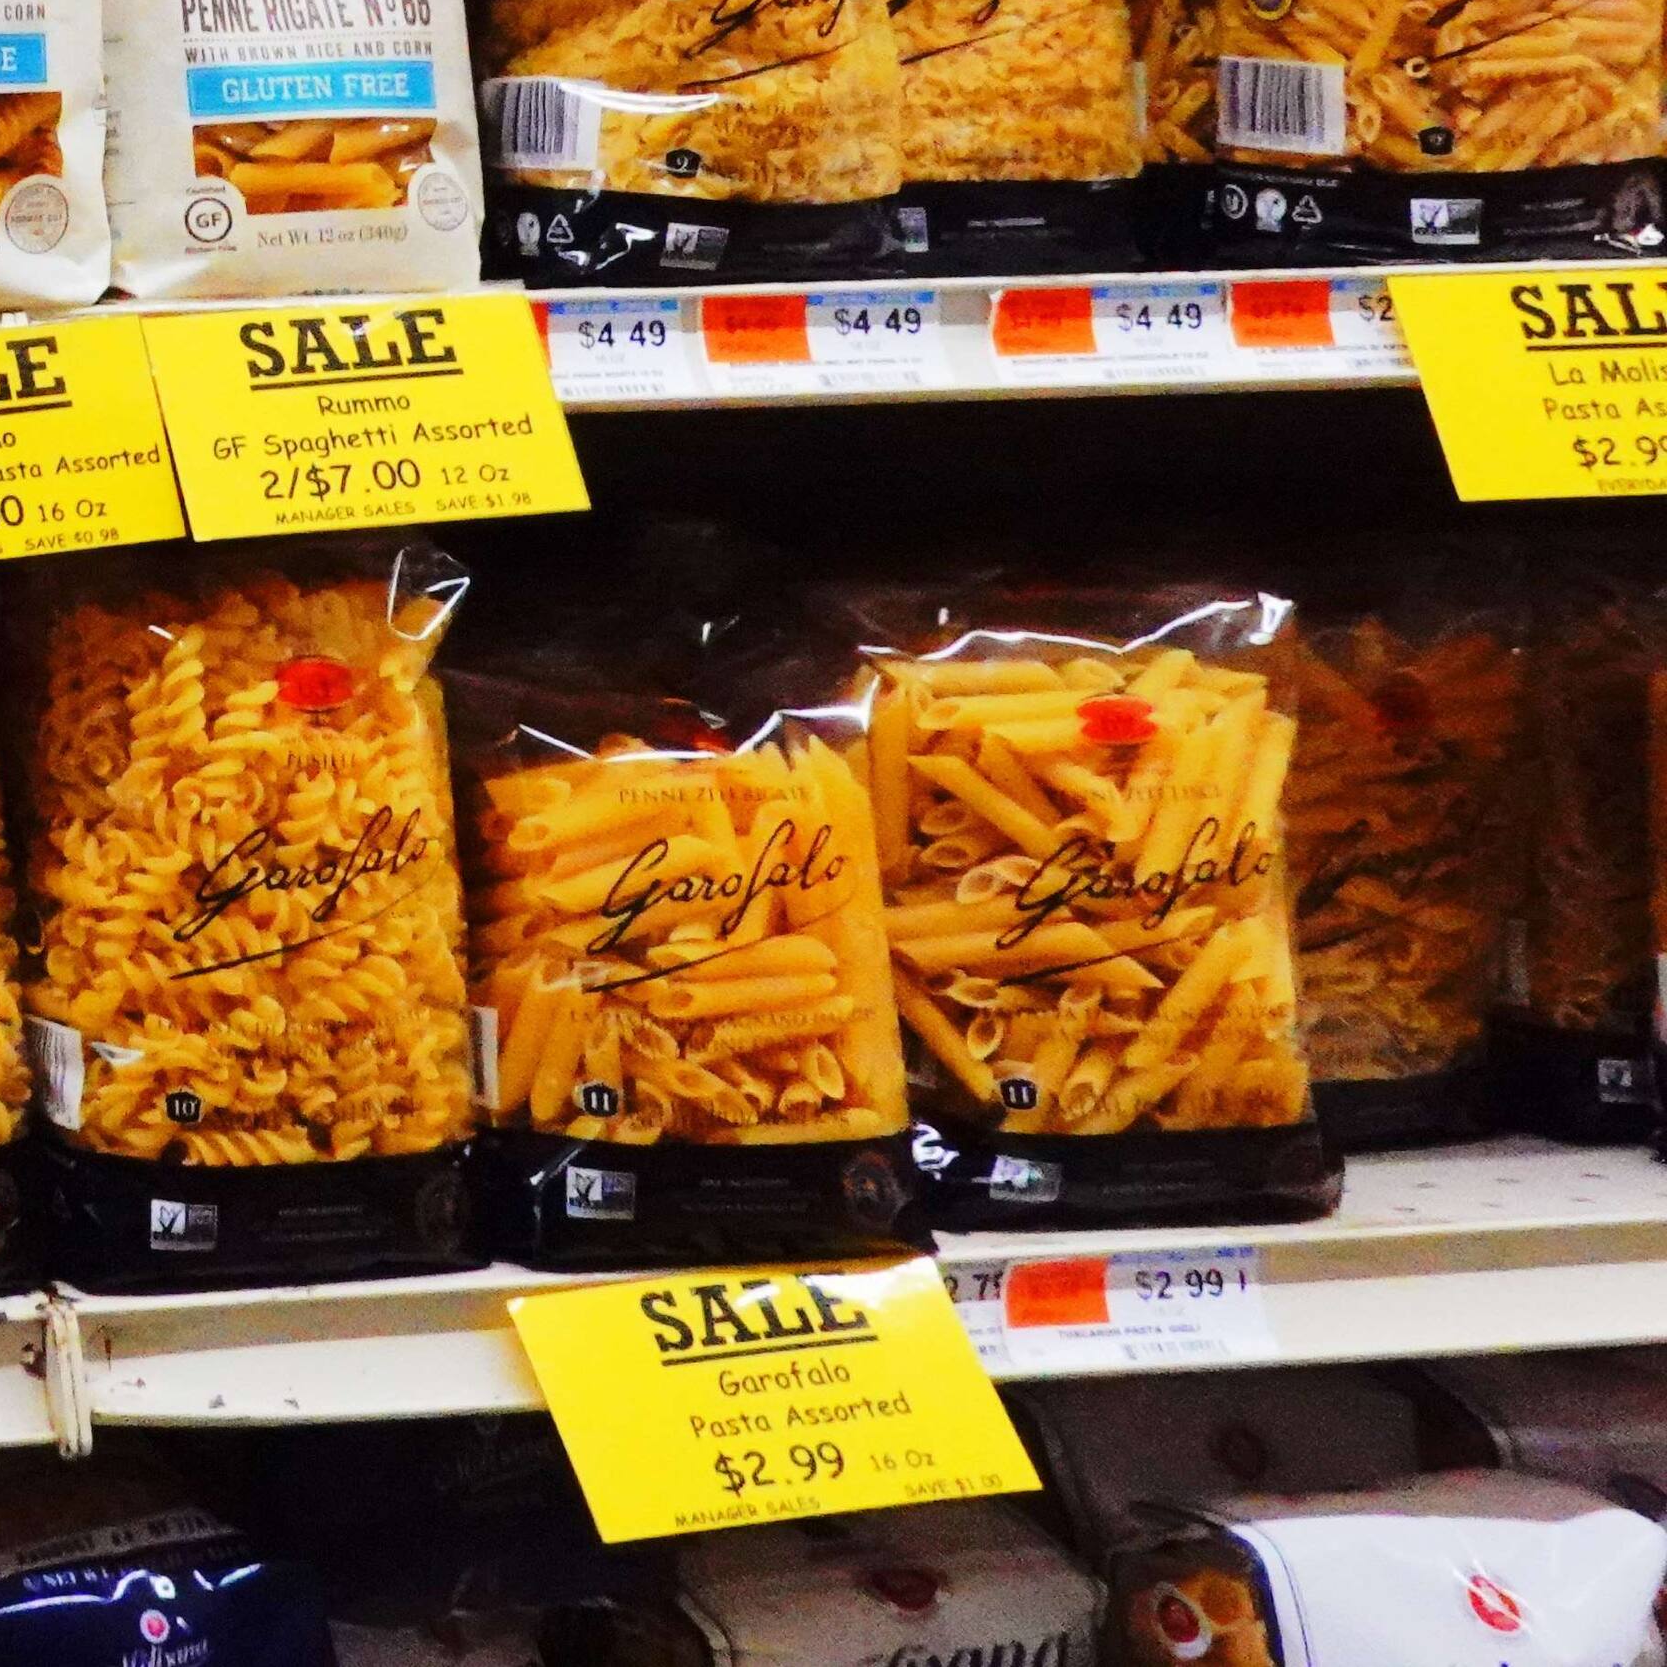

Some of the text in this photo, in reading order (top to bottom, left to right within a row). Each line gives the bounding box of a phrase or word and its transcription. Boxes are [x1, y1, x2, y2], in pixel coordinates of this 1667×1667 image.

[221, 72, 410, 104] GLUTEN FREE
[1510, 281, 1667, 339] SAL
[239, 307, 457, 379] SALE
[317, 394, 410, 416] Rummo
[1542, 398, 1621, 420] Pasta
[56, 445, 161, 475] Assorted
[213, 414, 533, 461] GF Spaghetti Assorted
[586, 816, 845, 954] Garofalo
[994, 815, 1272, 950] Garofalo
[639, 1269, 870, 1354] SALE
[717, 1360, 851, 1399] Garofalo
[688, 1391, 913, 1442] Pasta Assorted
[713, 1440, 936, 1497] $2.99 16 Oz
